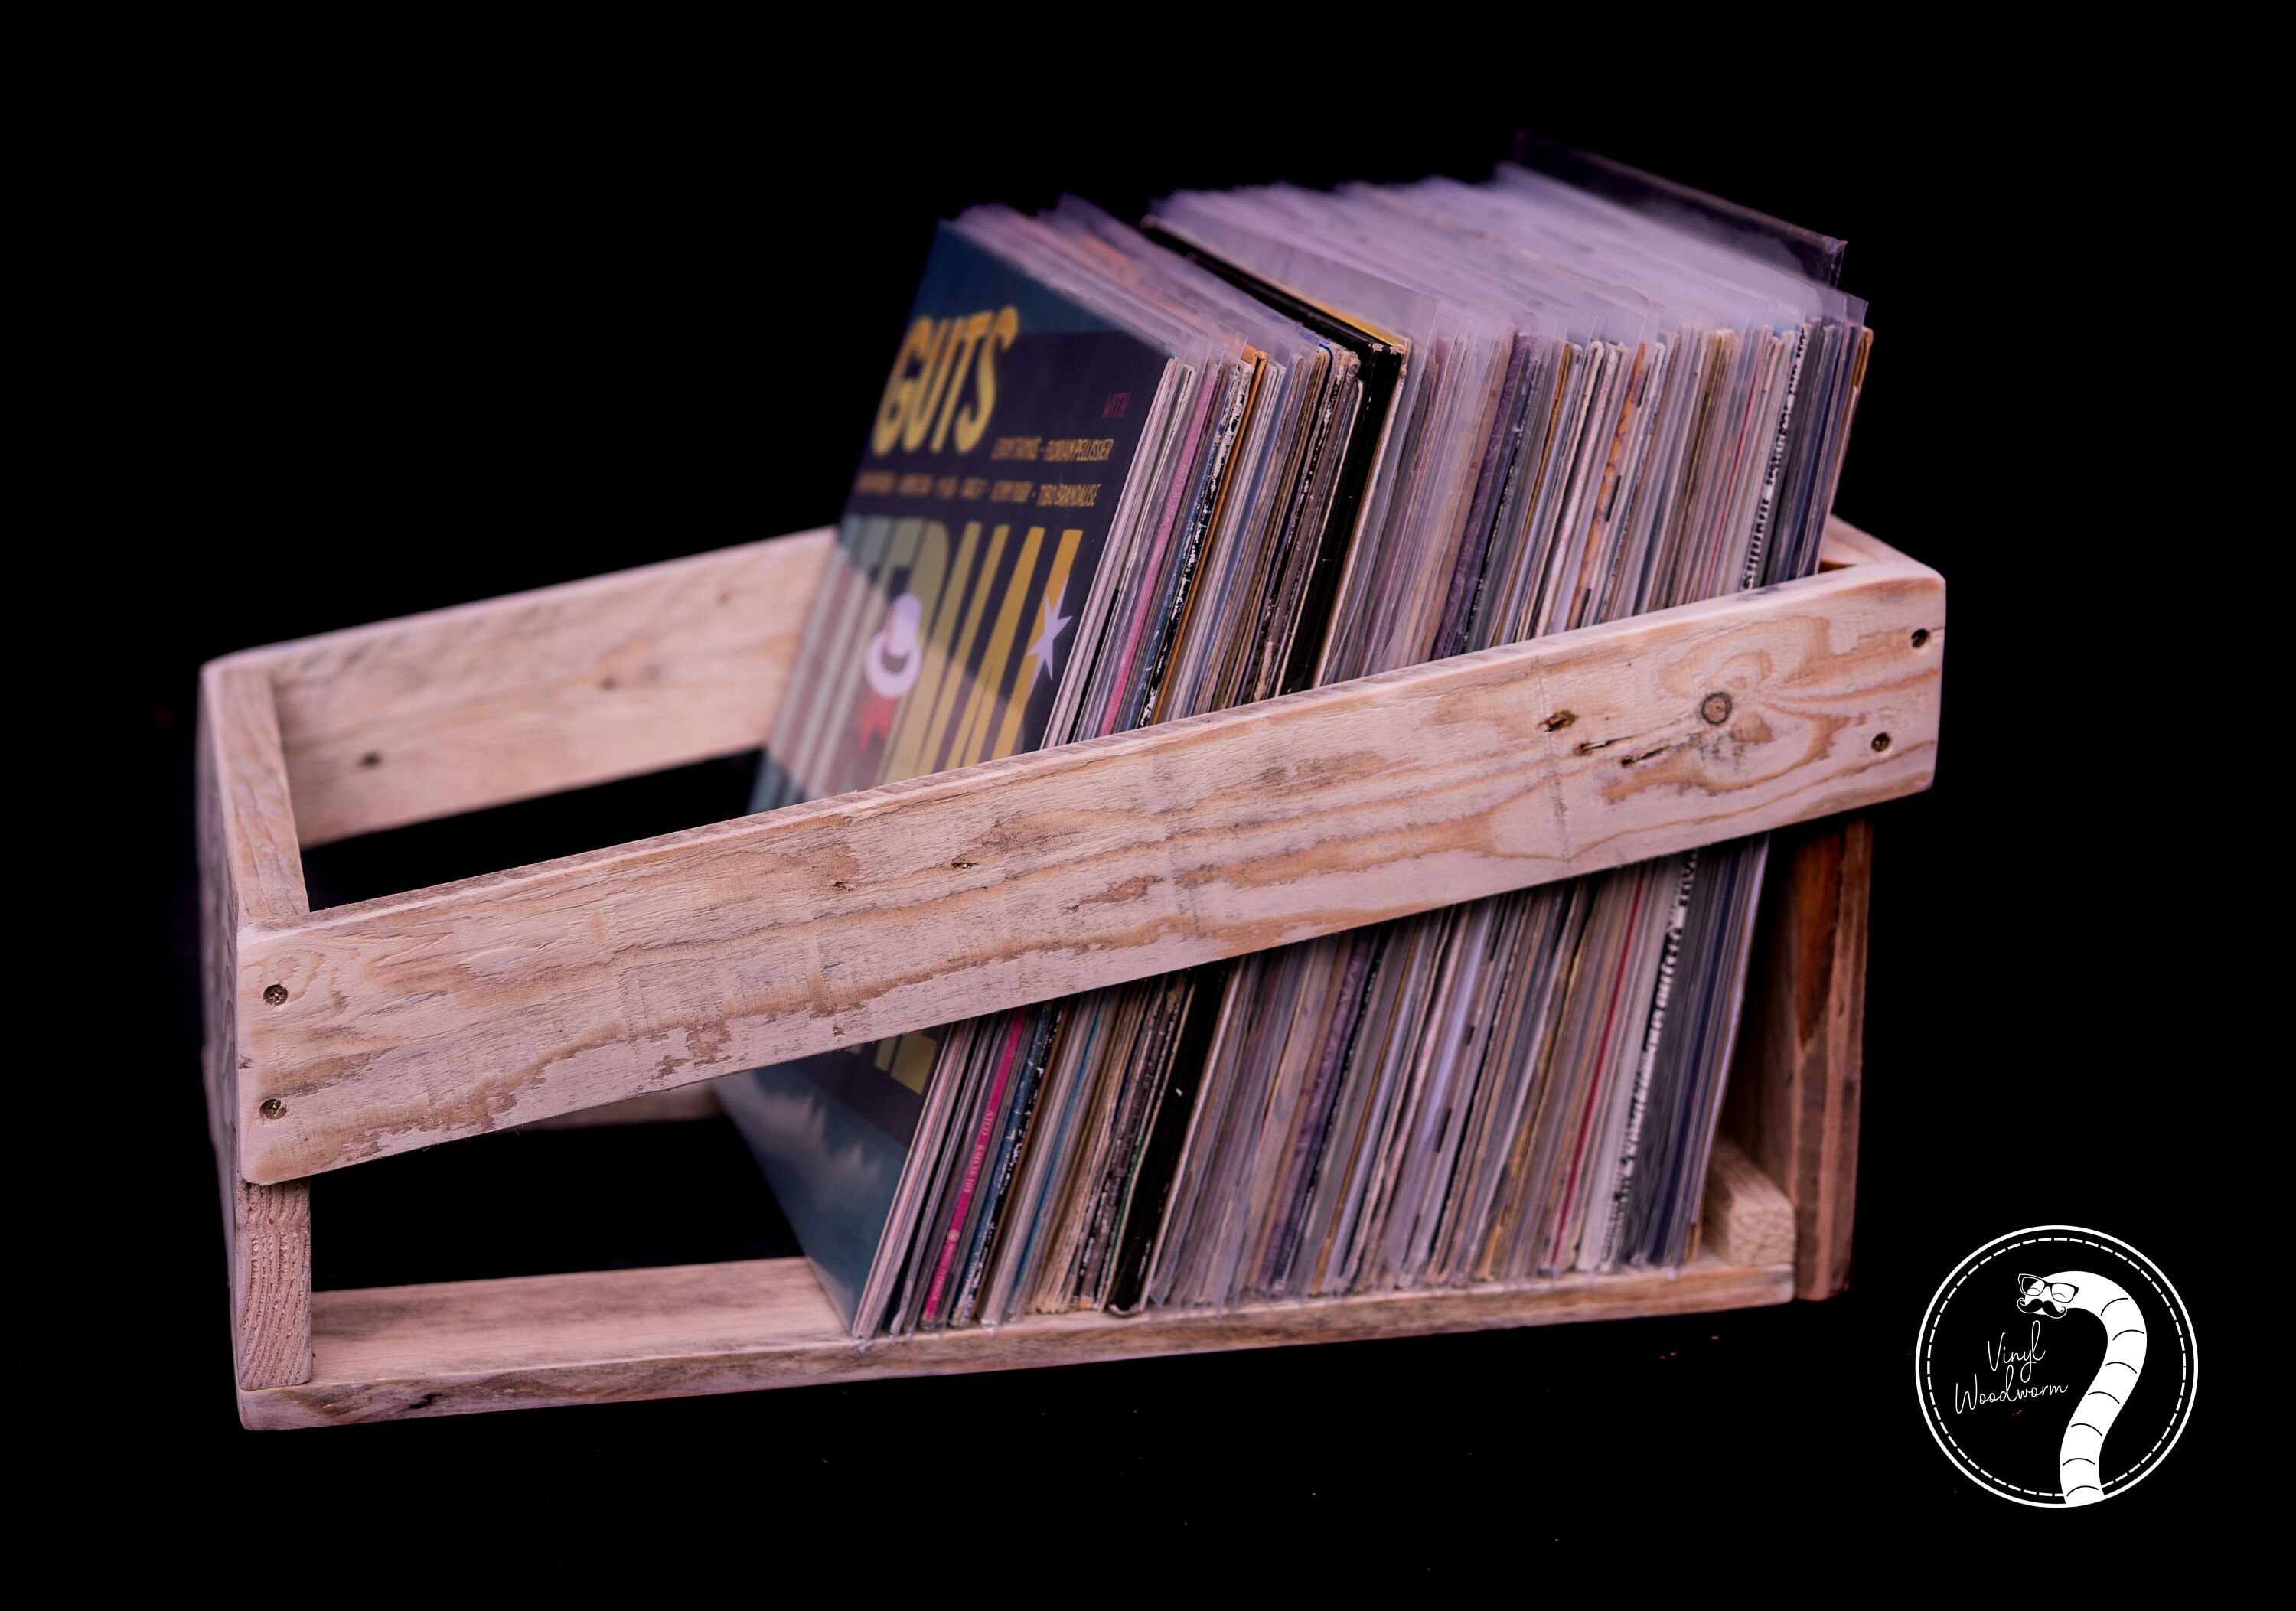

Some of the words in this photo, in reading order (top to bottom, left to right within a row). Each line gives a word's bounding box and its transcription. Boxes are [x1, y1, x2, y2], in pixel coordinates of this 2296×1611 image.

[872, 305, 1018, 456] GUTS
[1102, 391, 1131, 419] WITH
[1074, 438, 1114, 461] PELLISSIER
